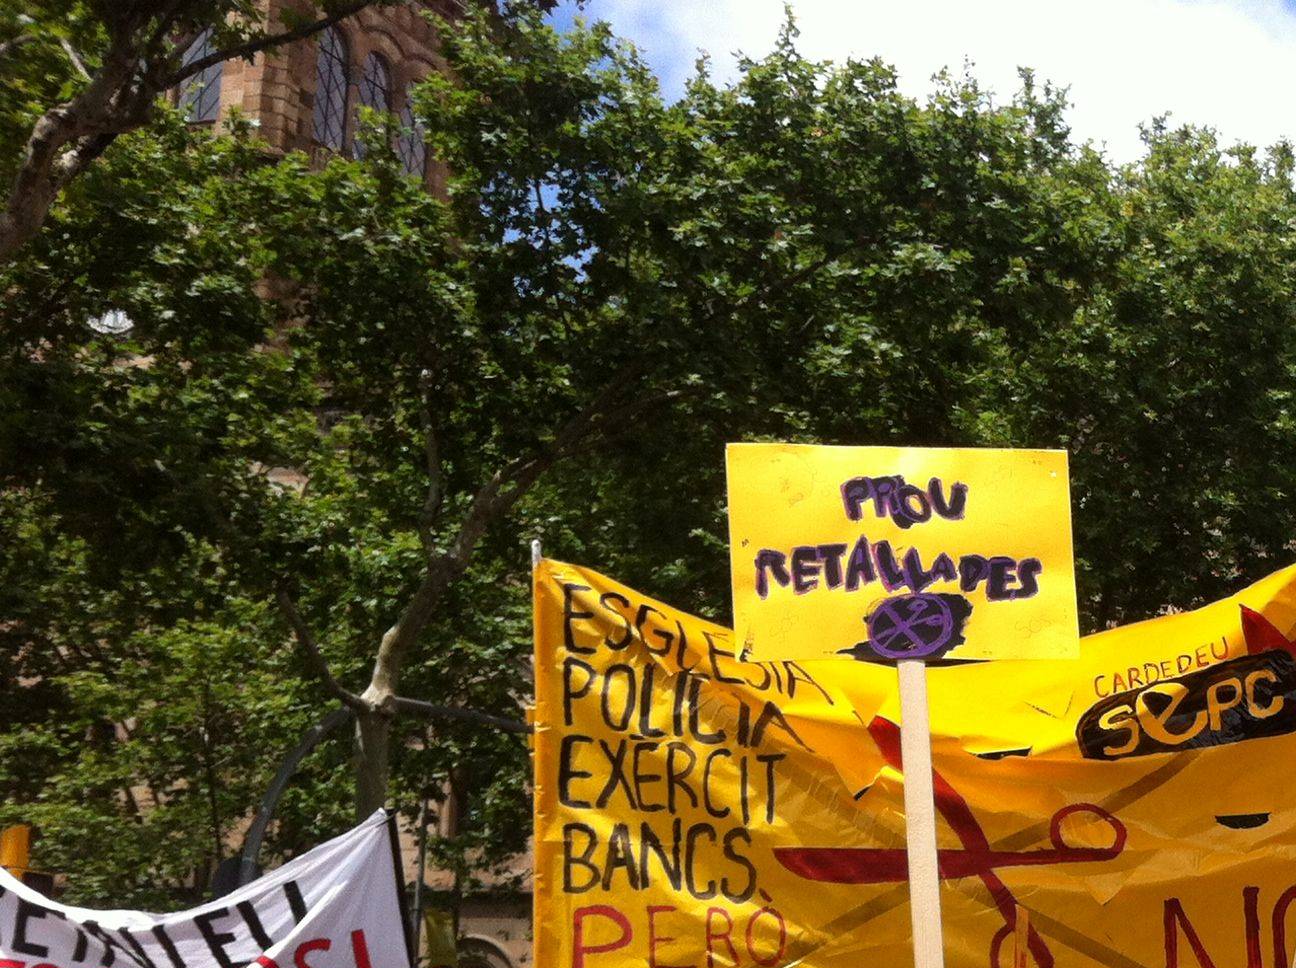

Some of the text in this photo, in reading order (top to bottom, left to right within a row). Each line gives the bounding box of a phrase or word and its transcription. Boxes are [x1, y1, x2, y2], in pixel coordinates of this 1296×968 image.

[841, 474, 968, 529] PROU
[1094, 636, 1229, 698] CARDEDEU
[563, 822, 757, 904] BANCS
